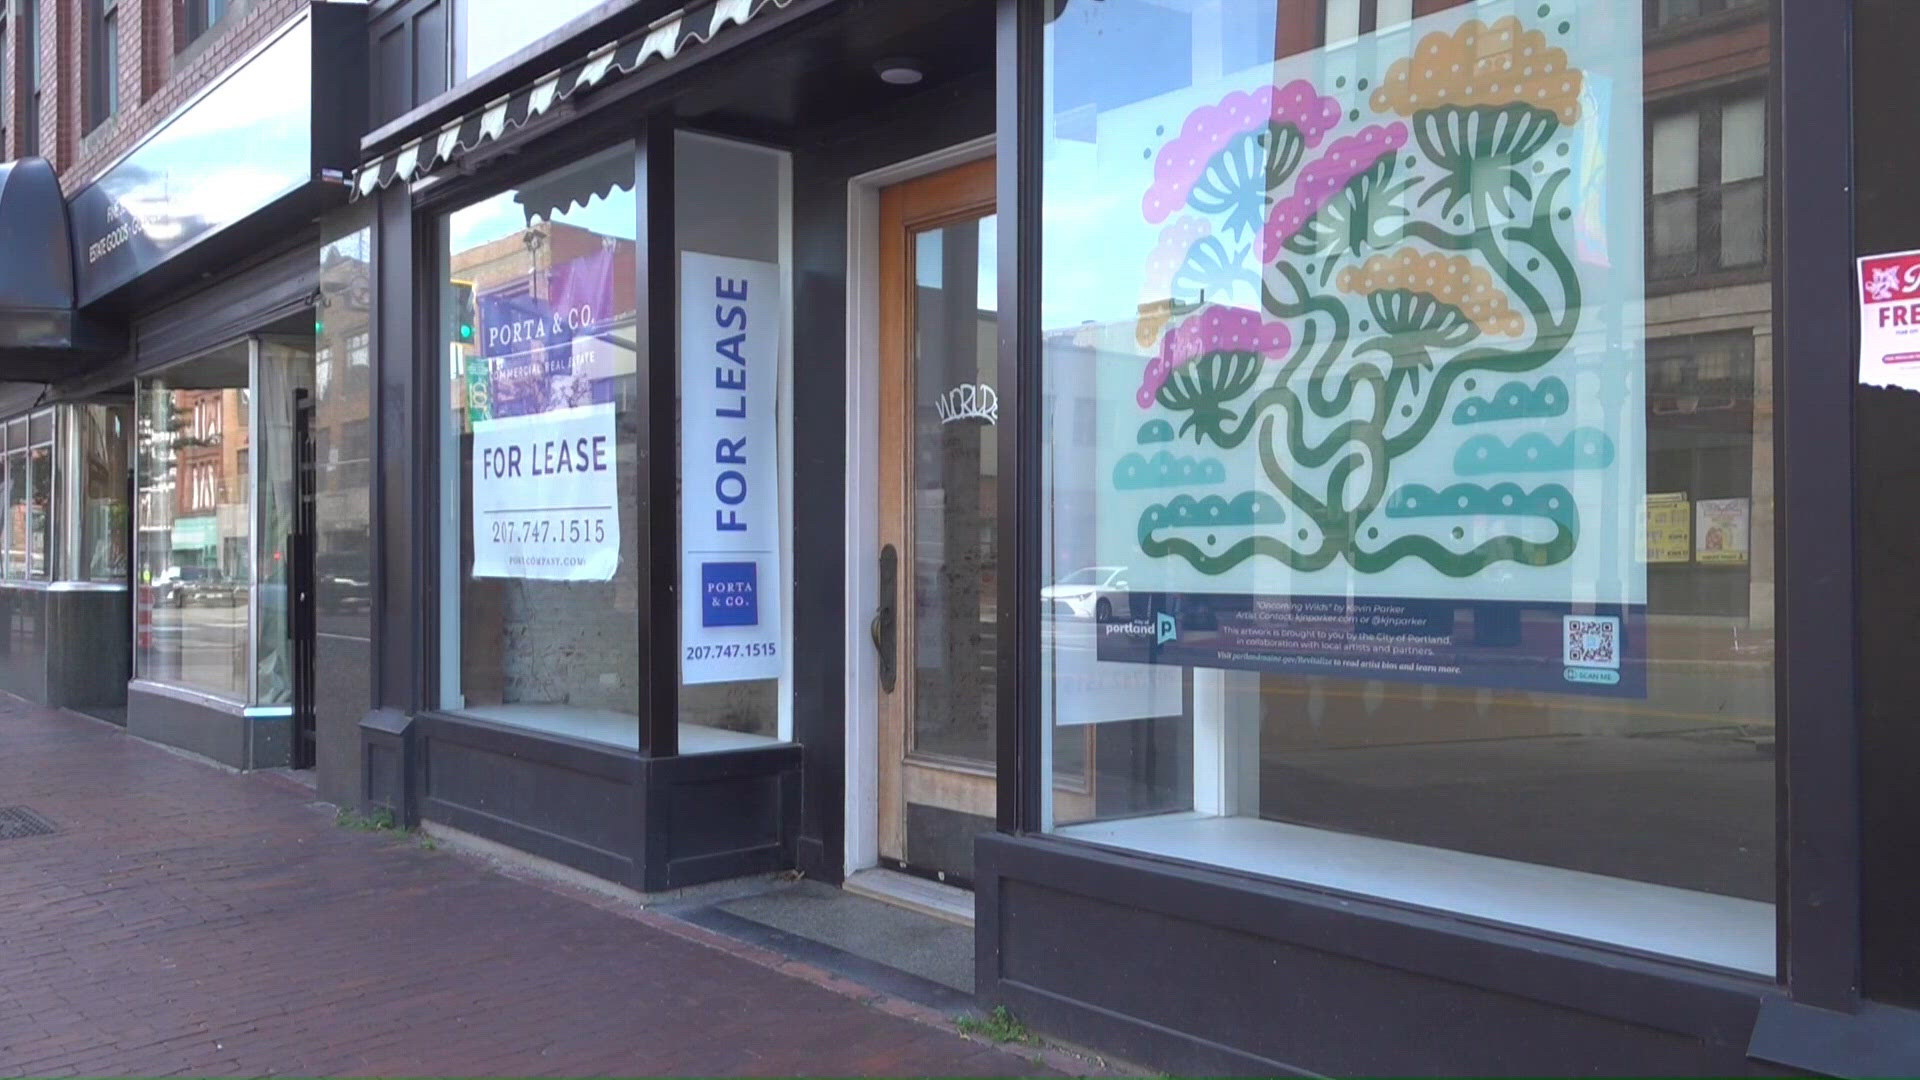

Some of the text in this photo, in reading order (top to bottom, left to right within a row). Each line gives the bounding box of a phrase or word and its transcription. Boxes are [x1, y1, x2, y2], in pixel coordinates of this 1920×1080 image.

[107, 223, 129, 252] GOODS
[489, 304, 595, 347] PORTA & CO.
[489, 363, 540, 381] OMMERCIAL
[545, 358, 564, 372] REAL
[716, 276, 748, 532] FOR LEASE
[484, 435, 607, 480] FOR LEASE
[492, 519, 605, 543] 207.747.1515
[707, 582, 752, 593] PORTA
[712, 596, 749, 607] & CO.
[1334, 603, 1345, 614] by
[1347, 604, 1371, 612] Kevin
[1374, 604, 1405, 613] Parker
[1236, 611, 1257, 619] Artist
[1106, 622, 1155, 636] portland
[1224, 626, 1240, 634] This
[1240, 627, 1272, 636] artwork
[1281, 629, 1315, 640] brought
[1317, 630, 1326, 639] to
[1328, 632, 1344, 641] you
[1346, 632, 1357, 641] by
[1359, 632, 1374, 641] the
[1376, 633, 1394, 643] City
[1396, 634, 1405, 642] of
[1407, 634, 1452, 646] Portland,
[687, 642, 776, 660] 207.747.1515
[1246, 638, 1298, 648] collaboration
[1300, 640, 1319, 649] with
[1321, 641, 1341, 650] local
[1343, 643, 1370, 652] artists
[1372, 644, 1390, 653] and
[1392, 645, 1435, 656] partners.
[1217, 651, 1232, 660] Visit
[1343, 659, 1359, 668] read
[1361, 660, 1380, 669] artist
[1382, 661, 1397, 670] bios
[1399, 662, 1414, 671] and
[1416, 663, 1436, 673] learn
[1438, 665, 1461, 675] more.
[1579, 671, 1612, 681] SCAN ME
